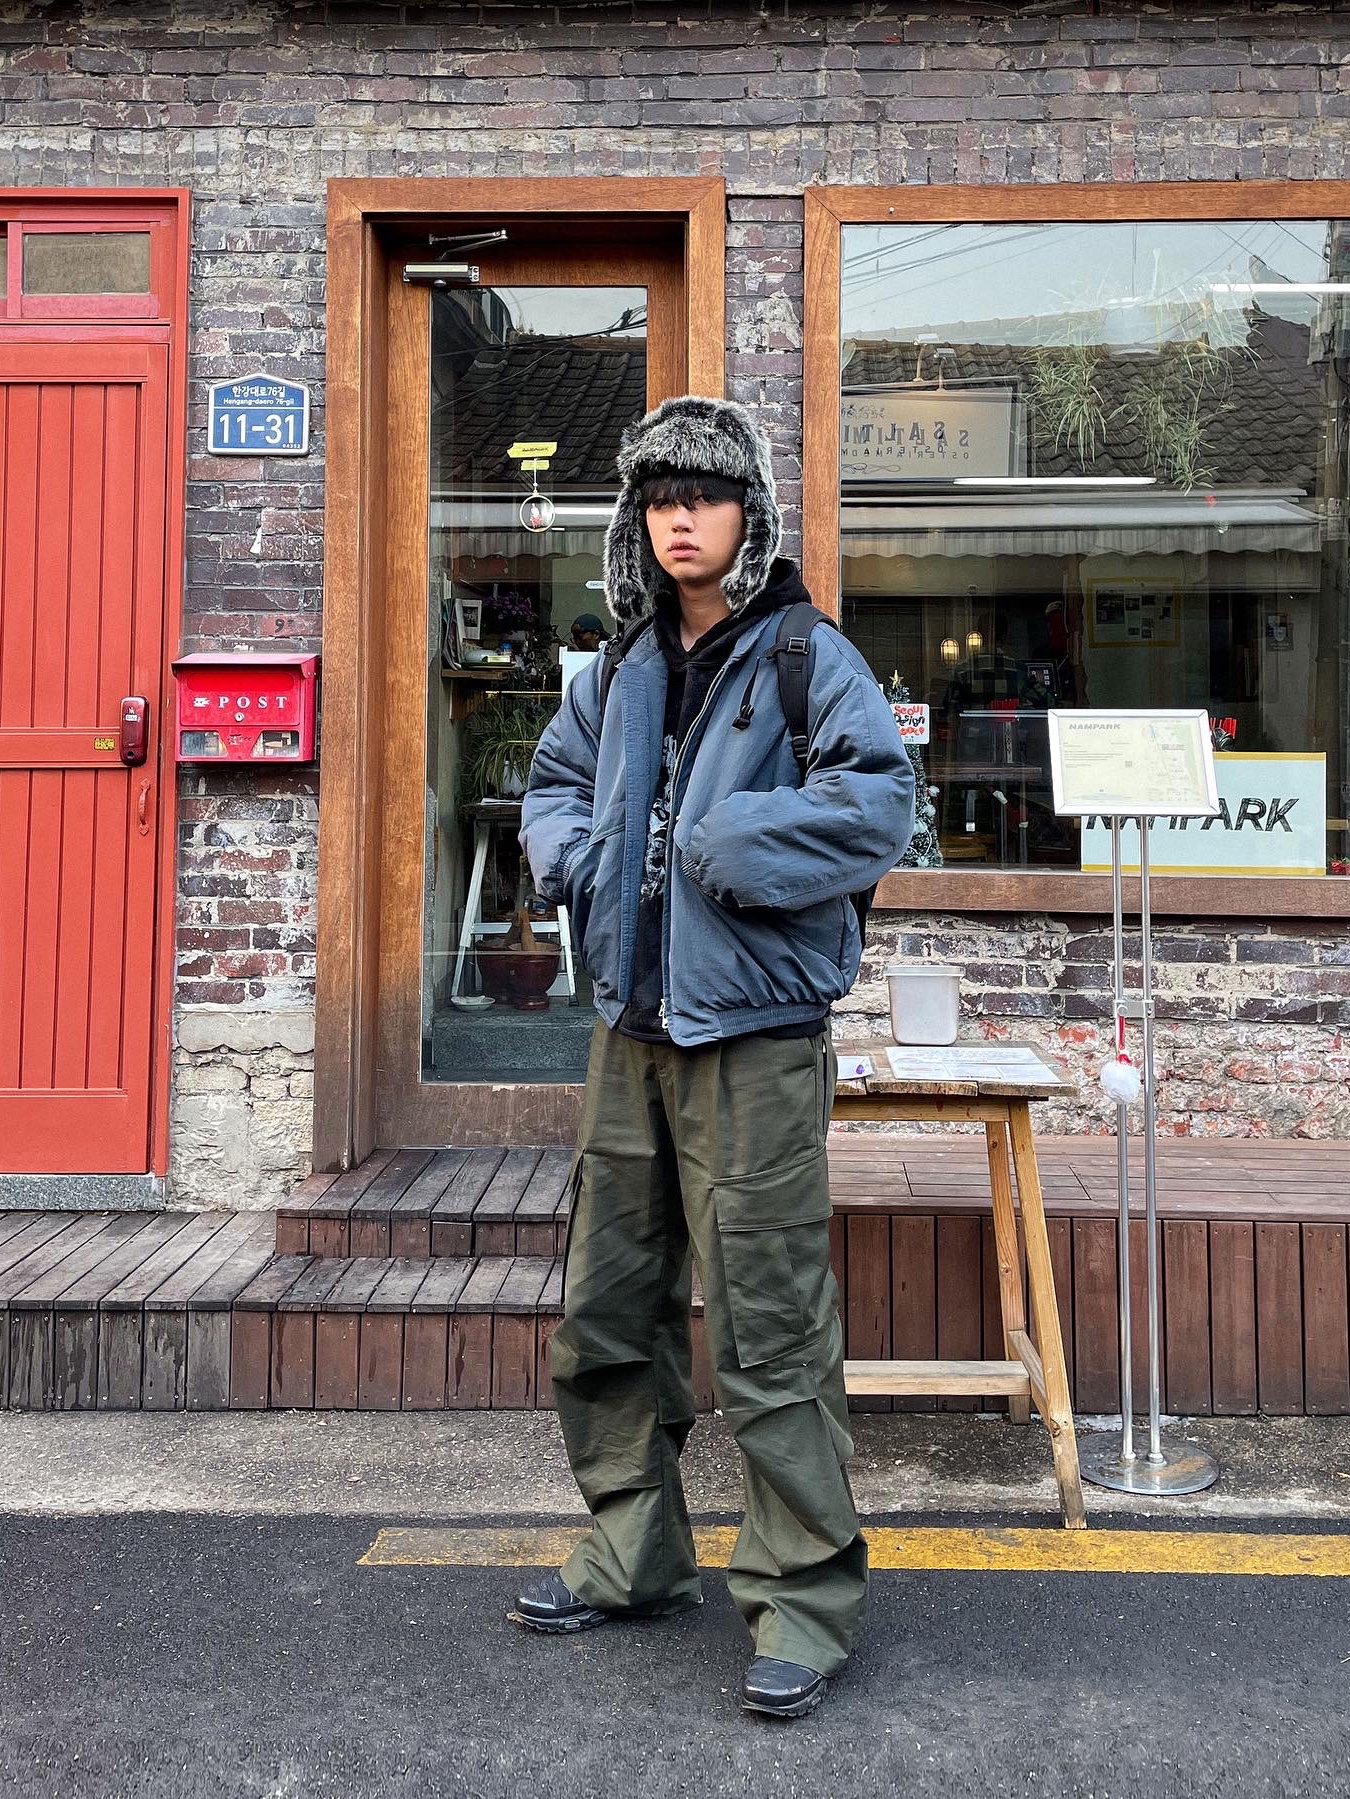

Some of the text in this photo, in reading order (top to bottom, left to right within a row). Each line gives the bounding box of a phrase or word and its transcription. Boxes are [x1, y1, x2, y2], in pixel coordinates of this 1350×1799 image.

[232, 386, 286, 397] 한강대로76길
[219, 414, 295, 444] 11-31
[218, 696, 287, 708] POST
